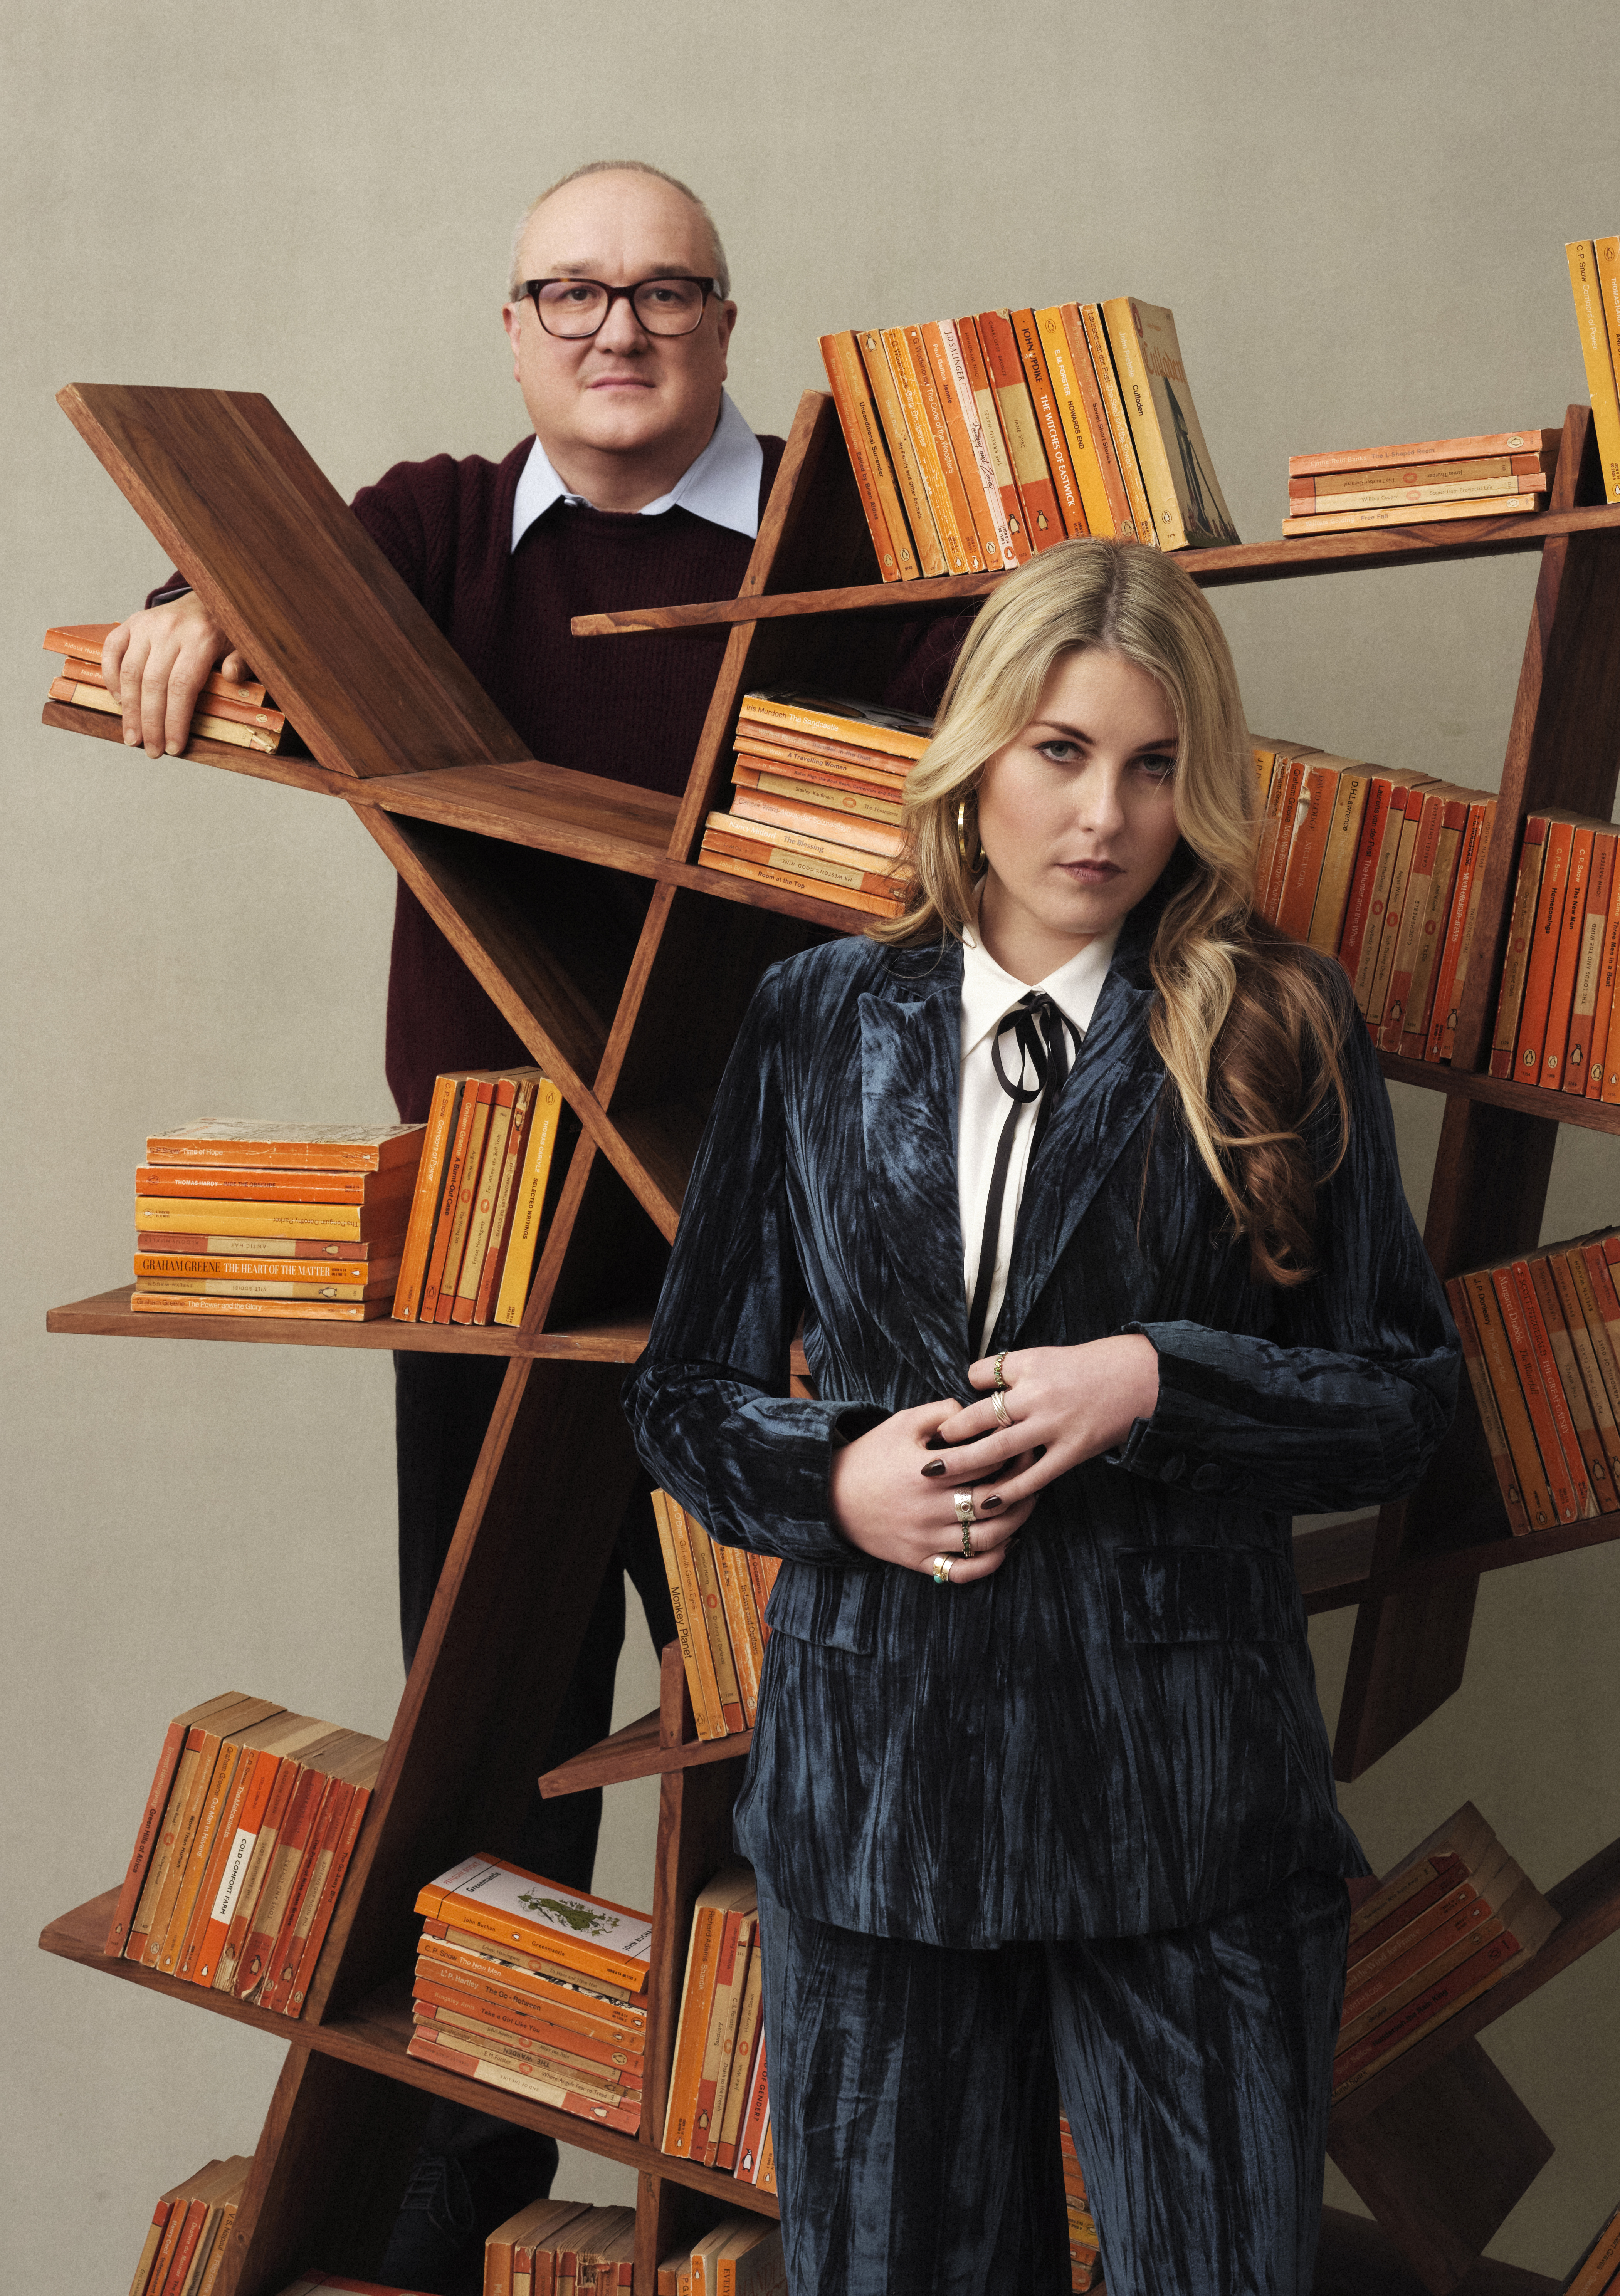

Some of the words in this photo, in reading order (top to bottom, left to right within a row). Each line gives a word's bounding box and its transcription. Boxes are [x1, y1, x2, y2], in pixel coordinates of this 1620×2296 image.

[1576, 244, 1583, 252] C.
[1579, 262, 1588, 282] Snow
[1582, 284, 1594, 318] Corridors
[1588, 318, 1595, 326] of
[932, 343, 941, 357] Paul
[1021, 327, 1035, 352] JOHN
[1589, 327, 1599, 351] Power
[914, 346, 931, 387] Wodehouse
[936, 359, 947, 381] Gallico
[1028, 352, 1043, 383] UPDIKE
[1055, 356, 1063, 364] M.
[1058, 364, 1071, 396] FORSTER
[926, 387, 936, 402] The
[943, 383, 953, 404] Jennie
[1040, 394, 1051, 414] THE
[1131, 384, 1145, 416] Culloden
[929, 401, 941, 421] Code
[1067, 400, 1081, 434] HOWARDS
[934, 421, 943, 430] of
[937, 428, 946, 441] the
[1044, 414, 1060, 450] WITCHES
[859, 401, 876, 445] Unconditional
[871, 446, 884, 478] Surrender
[1076, 436, 1085, 450] END
[940, 440, 955, 474] Woosters
[978, 449, 989, 465] and
[1054, 451, 1064, 464] OF
[1385, 449, 1415, 459] L-Shaped
[978, 463, 998, 491] Zooey
[1058, 464, 1076, 507] EASTWICK
[64, 642, 83, 651] Aldous
[746, 704, 757, 712] Iris
[757, 707, 787, 719] Murdoch
[788, 714, 802, 723] The
[802, 717, 839, 732] Sandcastle
[793, 754, 823, 766] Travelling
[824, 761, 847, 771] Woman
[795, 786, 811, 796] Stanley
[812, 791, 835, 801] Kauffmann
[874, 806, 899, 817] Philanderer
[1373, 785, 1385, 814] Laurens
[1371, 814, 1379, 827] van
[728, 821, 750, 833] Nancy
[750, 827, 776, 839] Mitford
[783, 836, 796, 845] The
[796, 839, 825, 854] Blessing
[1368, 827, 1377, 841] der
[1365, 841, 1374, 857] Post
[1362, 859, 1371, 873] The
[757, 871, 775, 880] Room
[793, 881, 805, 890] Top
[1358, 874, 1368, 897] Hunter
[1355, 898, 1364, 912] and
[1544, 887, 1557, 934] Homecomings
[1353, 913, 1361, 924] the
[1348, 925, 1358, 947] Whale
[460, 1102, 471, 1130] Graham
[455, 1130, 466, 1156] Greene
[447, 1163, 459, 1197] Burnt-Out
[528, 1177, 538, 1209] SELECTED
[444, 1198, 453, 1216] Case
[522, 1210, 532, 1239] WRITINGS
[143, 1259, 183, 1271] GRAHAM
[184, 1260, 220, 1272] GREENE
[224, 1263, 240, 1273] THE
[241, 1264, 267, 1274] HEART
[269, 1265, 279, 1274] OF
[280, 1265, 296, 1275] THE
[298, 1266, 330, 1276] MATTER
[1477, 1293, 1491, 1326] Donleavy
[1497, 1276, 1515, 1311] Margaret
[1509, 1312, 1524, 1344] Drabble
[1542, 1359, 1552, 1376] THE
[1547, 1376, 1560, 1404] GREAT
[1554, 1404, 1570, 1434] GATSBY
[669, 1586, 686, 1625] Monkey
[679, 1628, 692, 1659] Planet
[221, 1746, 233, 1772] Graham
[213, 1772, 226, 1797] Greene
[210, 1797, 219, 1810] Our
[206, 1810, 215, 1825] Man
[196, 1833, 208, 1857] Havana
[237, 1838, 247, 1858] COLD
[225, 1860, 240, 1895] COMFORT
[467, 1871, 501, 1892] Greenmantle
[220, 1895, 230, 1915] FARM
[705, 1910, 714, 1937] Richard
[463, 1917, 476, 1925] John
[477, 1922, 496, 1932] Buchan
[531, 1941, 566, 1957] Greenmantle
[702, 1938, 711, 1962] Adams
[439, 1949, 458, 1961] Snow
[458, 1956, 472, 1966] The
[471, 1961, 487, 1971] New
[487, 1967, 502, 1977] Men
[698, 1964, 707, 1991] Shardik
[761, 2071, 767, 2081] OF
[753, 2084, 765, 2121] GENDER?
[166, 2220, 177, 2238] Henry
[184, 2222, 197, 2245] Daphne
[225, 2219, 233, 2227] S.
[162, 2238, 171, 2254] Cecil
[183, 2245, 190, 2254] du
[217, 2226, 230, 2251] Naipaul
[175, 2254, 187, 2277] Maurier
